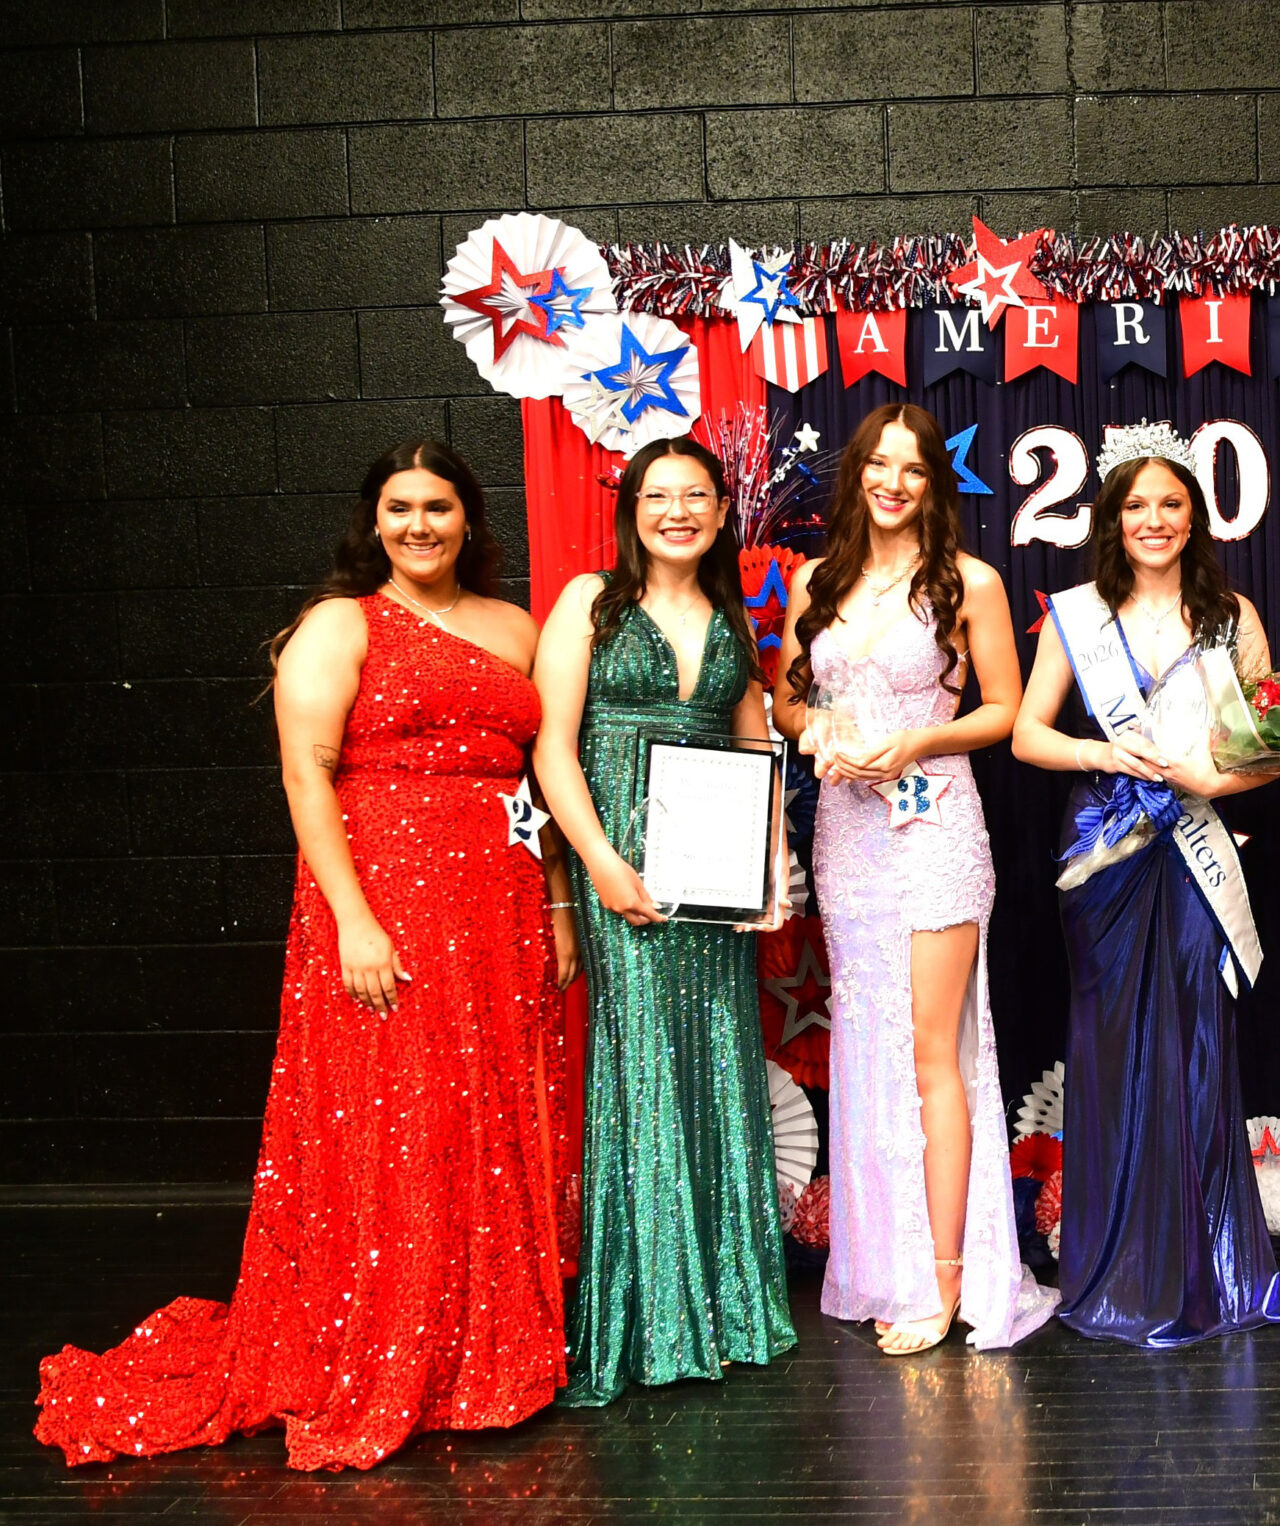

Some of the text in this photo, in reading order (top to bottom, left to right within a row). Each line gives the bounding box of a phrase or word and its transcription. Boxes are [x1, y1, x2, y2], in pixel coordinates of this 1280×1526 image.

[1009, 418, 1271, 549] 20
[1079, 641, 1119, 672] 2026
[897, 775, 931, 815] 3
[512, 798, 533, 840] 2
[1176, 812, 1226, 887] alters
